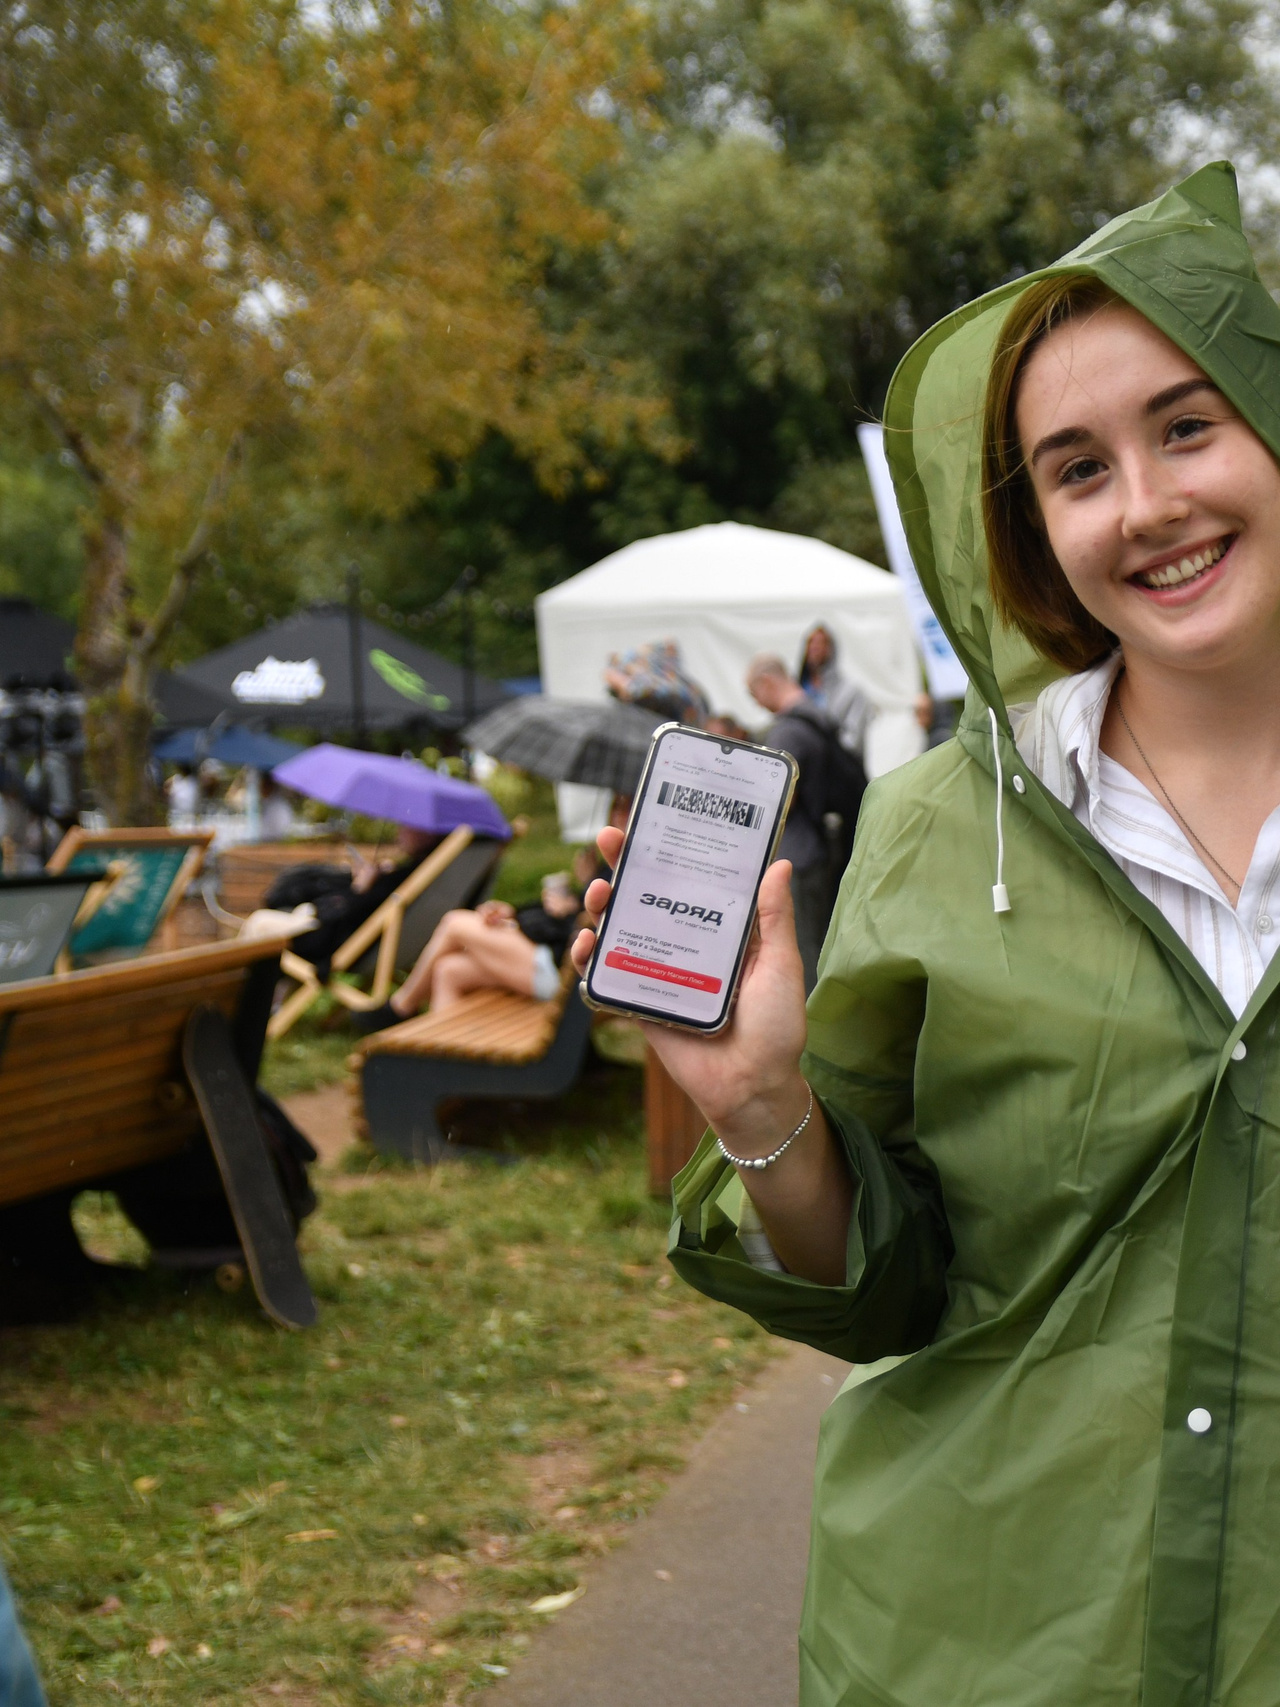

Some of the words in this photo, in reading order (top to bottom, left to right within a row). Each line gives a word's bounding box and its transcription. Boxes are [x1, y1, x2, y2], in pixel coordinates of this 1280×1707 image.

[715, 757, 733, 765] Купон
[639, 893, 724, 926] заряд
[685, 922, 718, 933] магнита
[618, 929, 643, 940] Скидка
[644, 935, 658, 943] 20%
[673, 944, 699, 954] покупке
[649, 946, 673, 955] Заряде
[622, 959, 650, 970] Показать
[650, 967, 666, 975] карту
[667, 971, 688, 980] Магнит
[689, 976, 704, 984] Плюс
[638, 983, 661, 993] Удалить
[661, 990, 679, 998] купон
